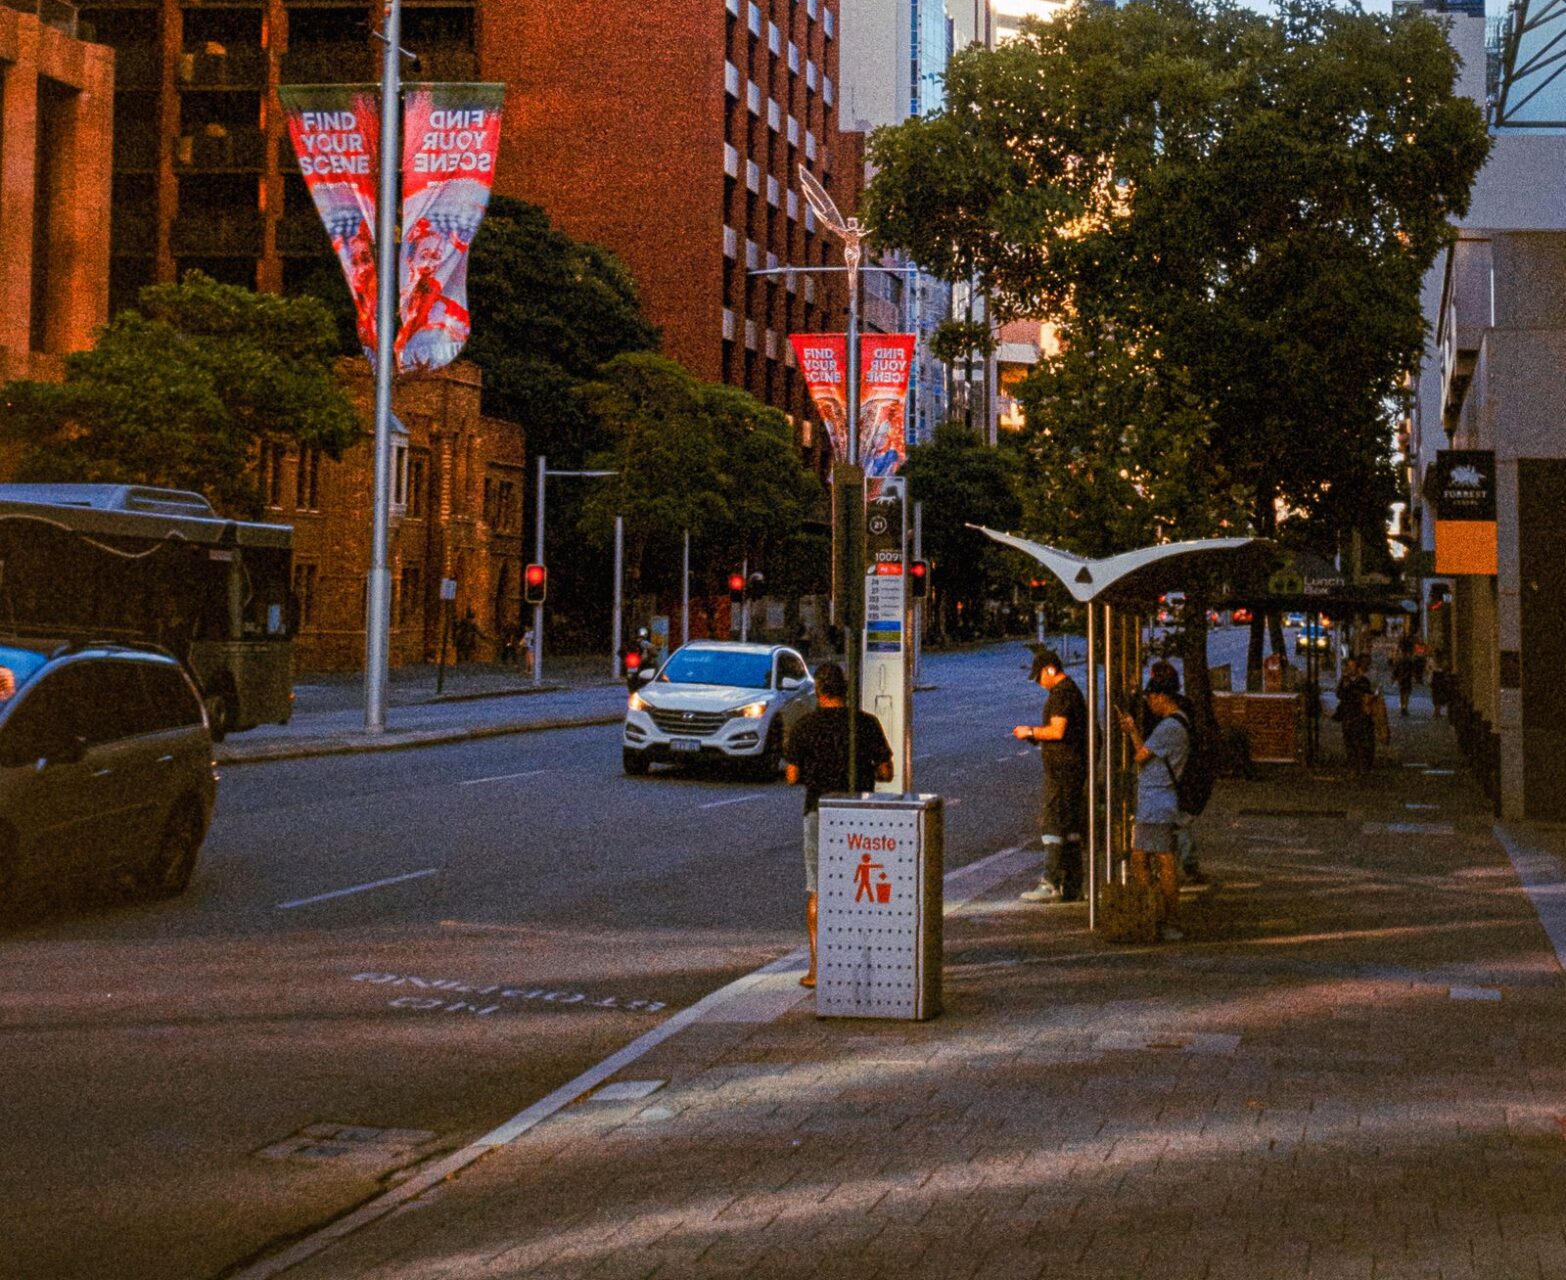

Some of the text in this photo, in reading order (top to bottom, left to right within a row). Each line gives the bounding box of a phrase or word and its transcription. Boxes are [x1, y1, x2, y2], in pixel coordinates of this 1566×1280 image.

[302, 111, 357, 131] FIND
[301, 133, 364, 152] YOUR
[298, 154, 370, 175] SCENE
[803, 347, 834, 359] FIND
[803, 359, 837, 371] YOUR
[1443, 490, 1488, 499] FORREST
[1303, 575, 1345, 587] Lunch
[847, 832, 897, 852] Waste
